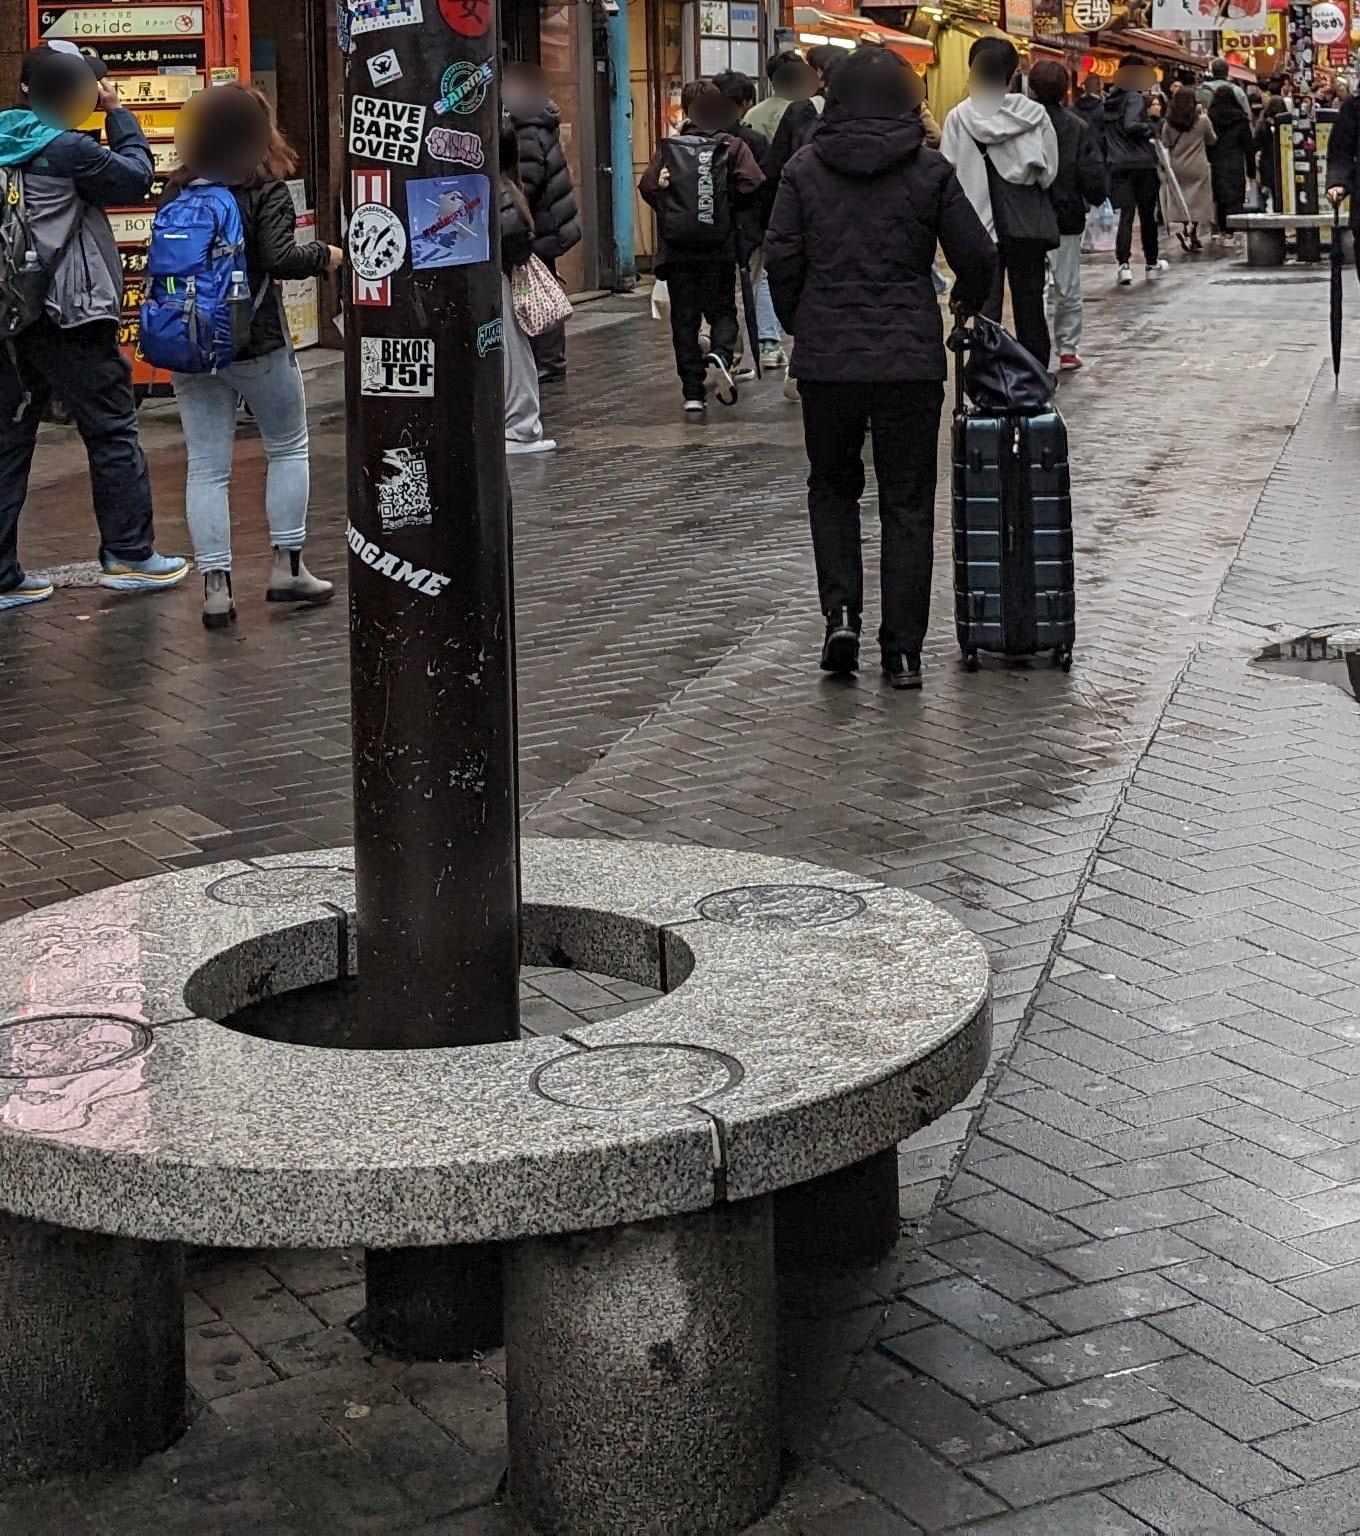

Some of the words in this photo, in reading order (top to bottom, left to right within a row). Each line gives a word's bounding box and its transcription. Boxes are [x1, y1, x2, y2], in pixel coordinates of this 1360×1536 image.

[73, 20, 133, 34] toride
[354, 97, 421, 124] CRAVE
[353, 116, 419, 144] BARS
[352, 136, 415, 163] OVER
[381, 363, 433, 386] T5F
